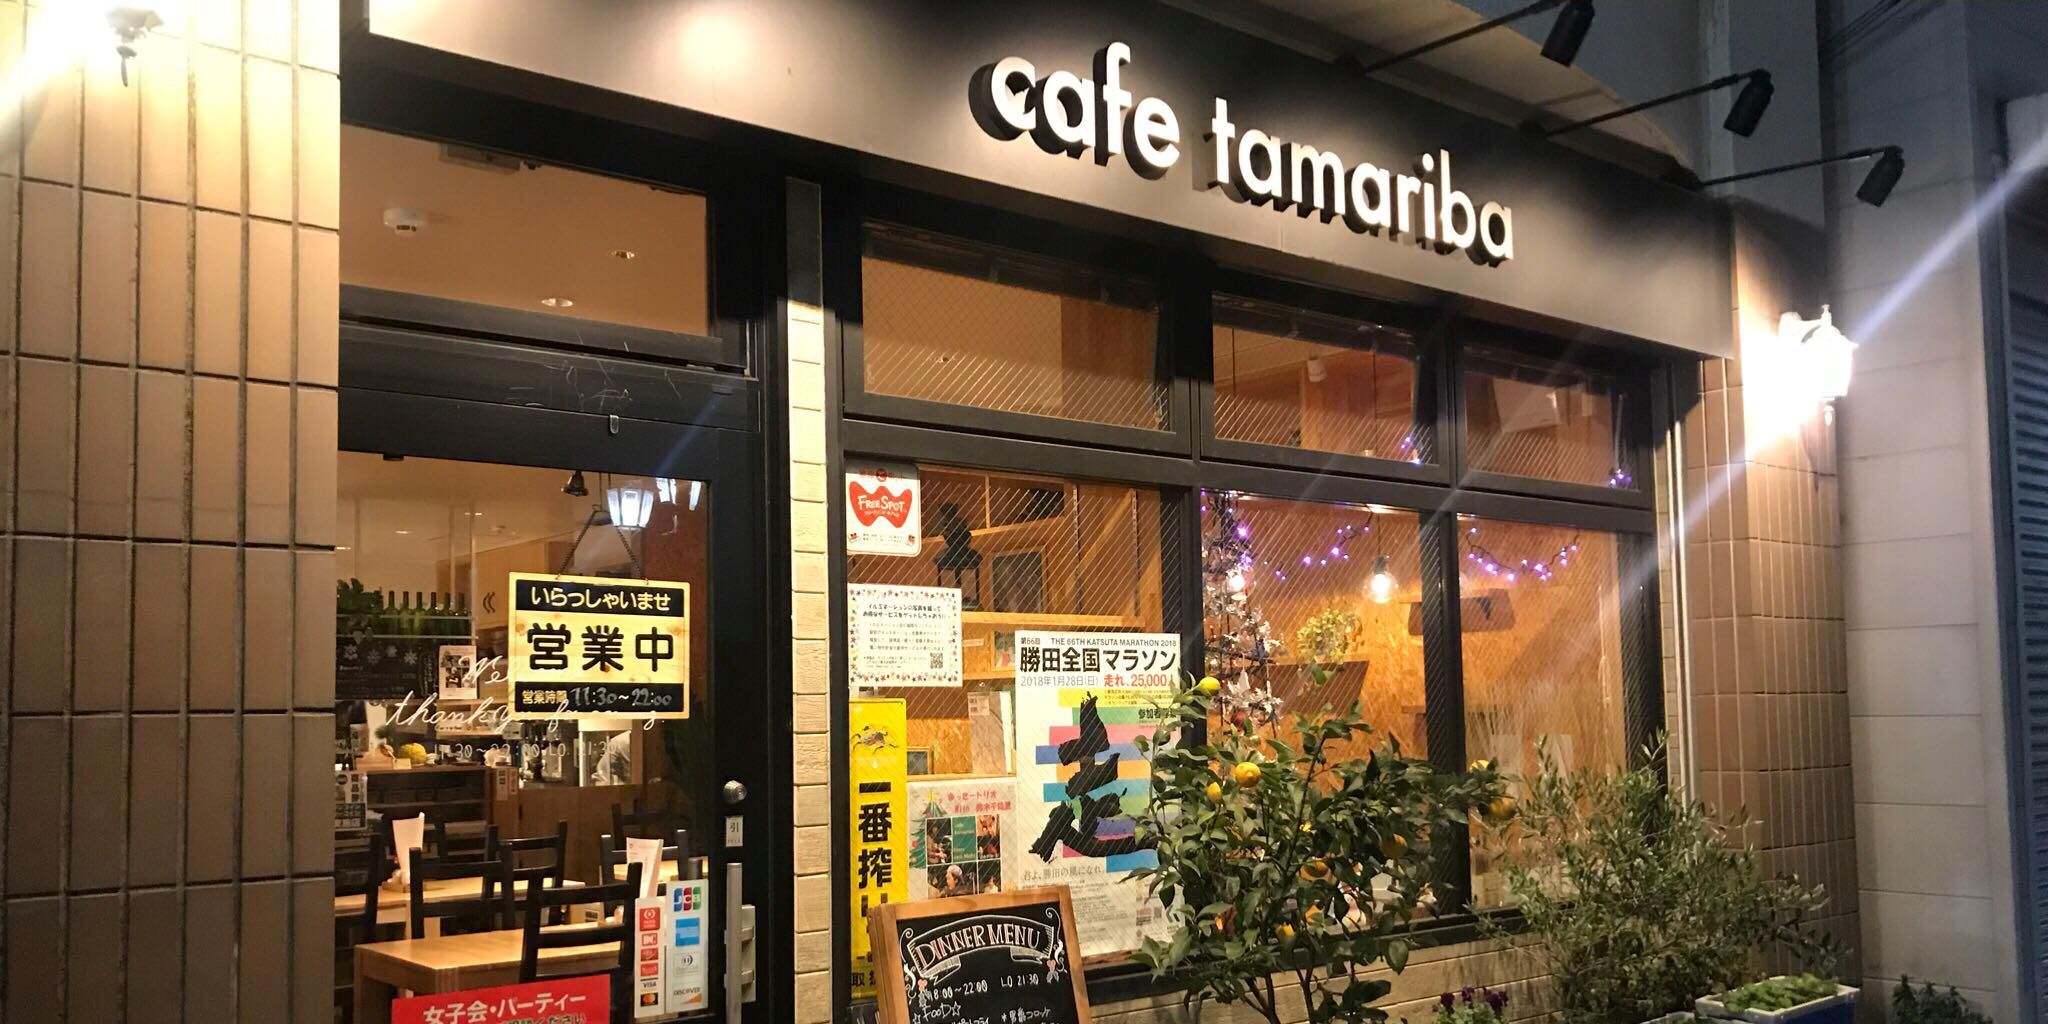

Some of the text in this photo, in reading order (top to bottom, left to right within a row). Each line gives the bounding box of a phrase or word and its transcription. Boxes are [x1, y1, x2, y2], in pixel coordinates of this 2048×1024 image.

[980, 42, 1514, 262] cafe tamariba
[531, 586, 671, 612] いらっしゃいませ
[527, 622, 674, 672] 営業中
[1050, 637, 1177, 648] THE 66TH KATSUTA MARATHON 2018
[1020, 646, 1177, 673] 勝田全国マラソン
[521, 689, 568, 705] 営業時間
[914, 923, 1041, 970] DINNER MENU
